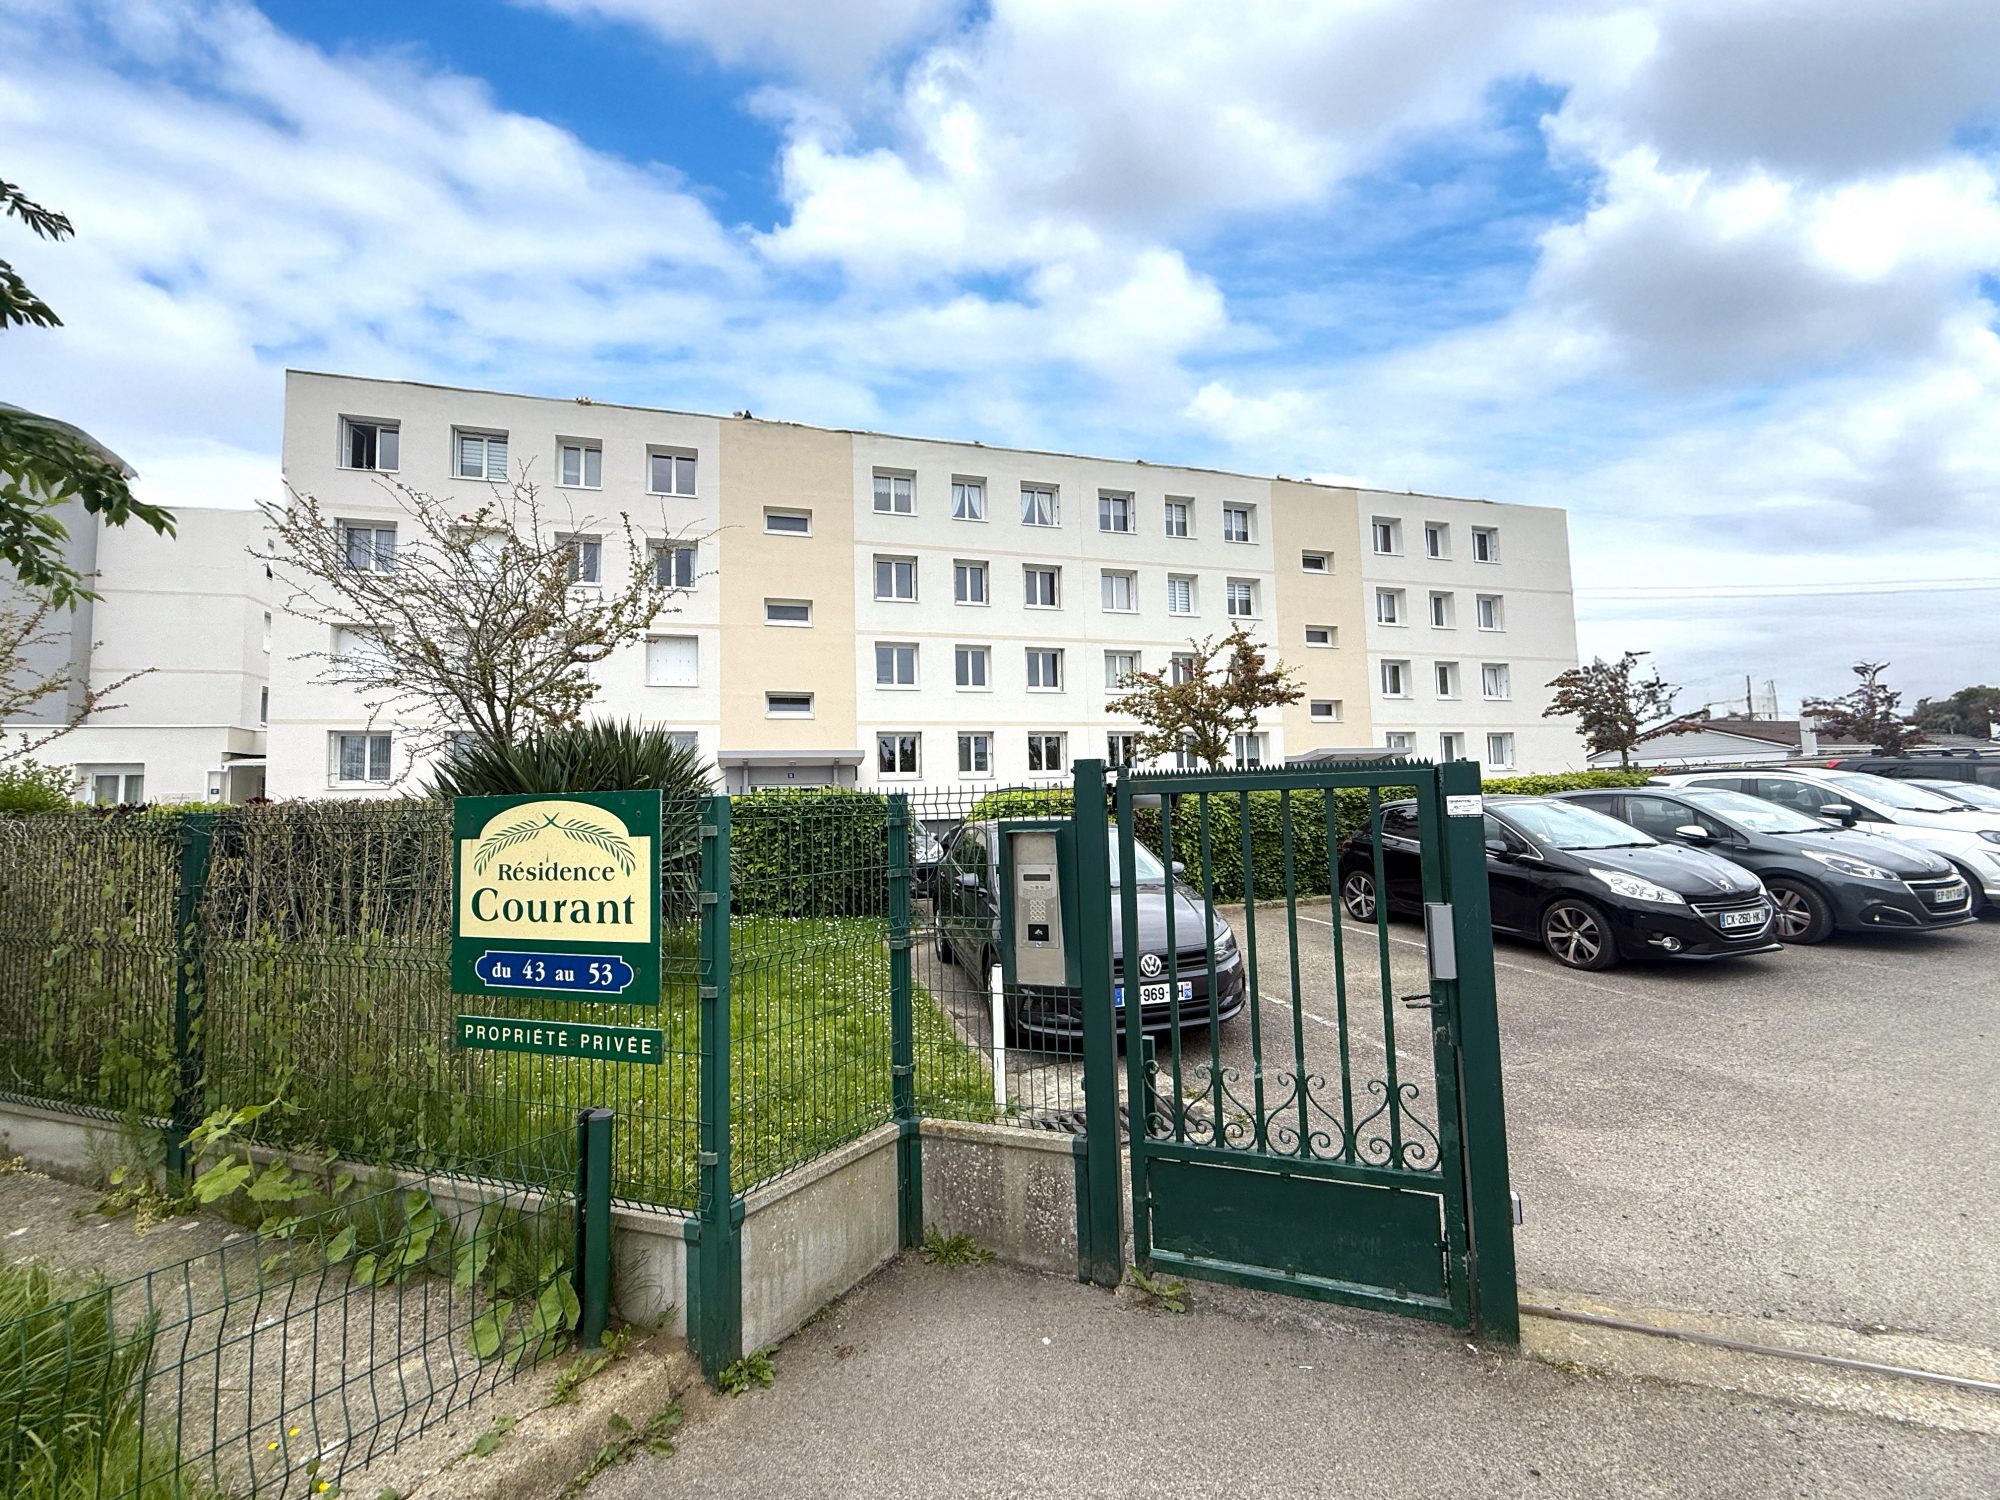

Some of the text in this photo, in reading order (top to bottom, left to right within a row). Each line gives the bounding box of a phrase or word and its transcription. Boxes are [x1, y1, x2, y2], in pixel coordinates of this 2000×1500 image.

[498, 861, 615, 881] Résidence
[471, 887, 635, 924] Courant
[492, 959, 613, 985] du 43 au 53
[465, 1024, 652, 1054] PROPRIÉTÉ PRIVÉE
